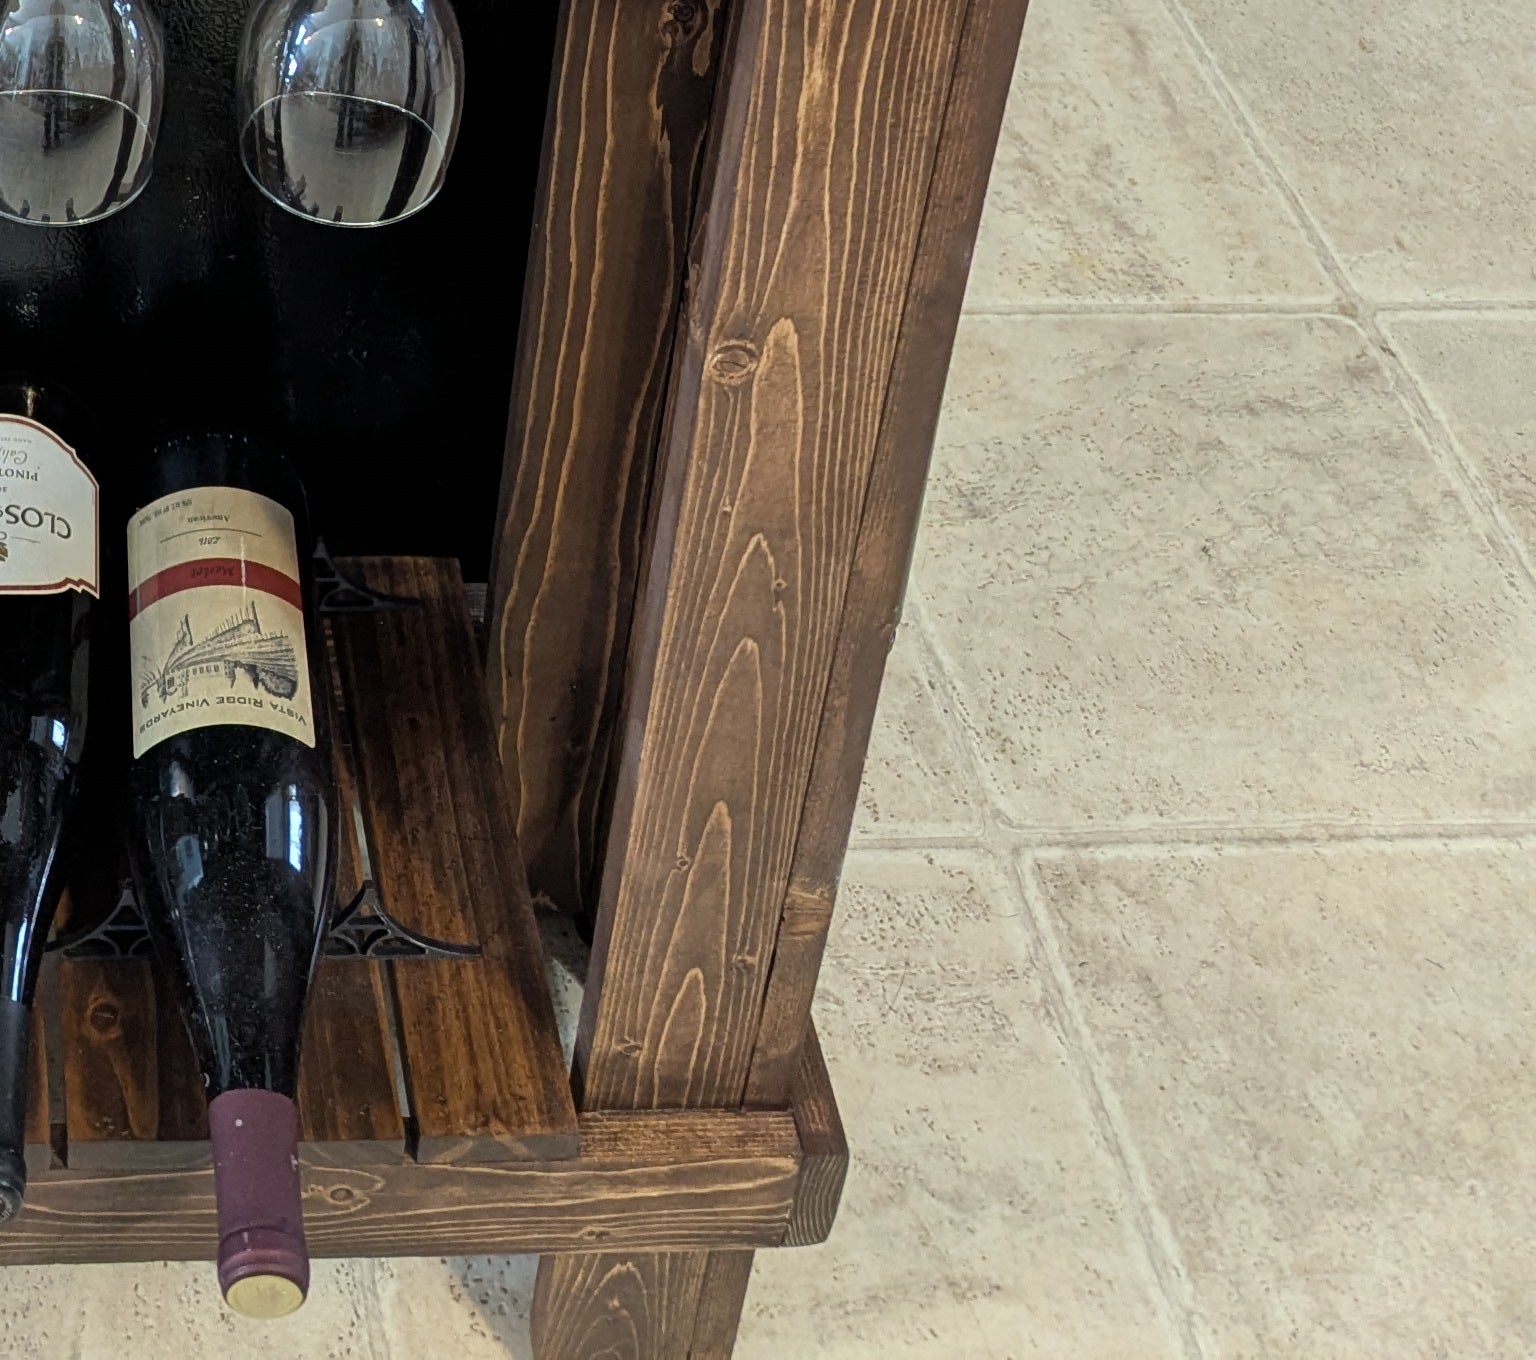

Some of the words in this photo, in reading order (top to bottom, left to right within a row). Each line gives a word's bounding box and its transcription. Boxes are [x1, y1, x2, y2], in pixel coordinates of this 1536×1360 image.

[5, 504, 72, 539] CLOS
[139, 697, 210, 734] VINEYARDS
[215, 695, 264, 708] RIDGE
[270, 701, 307, 726] VISTA
